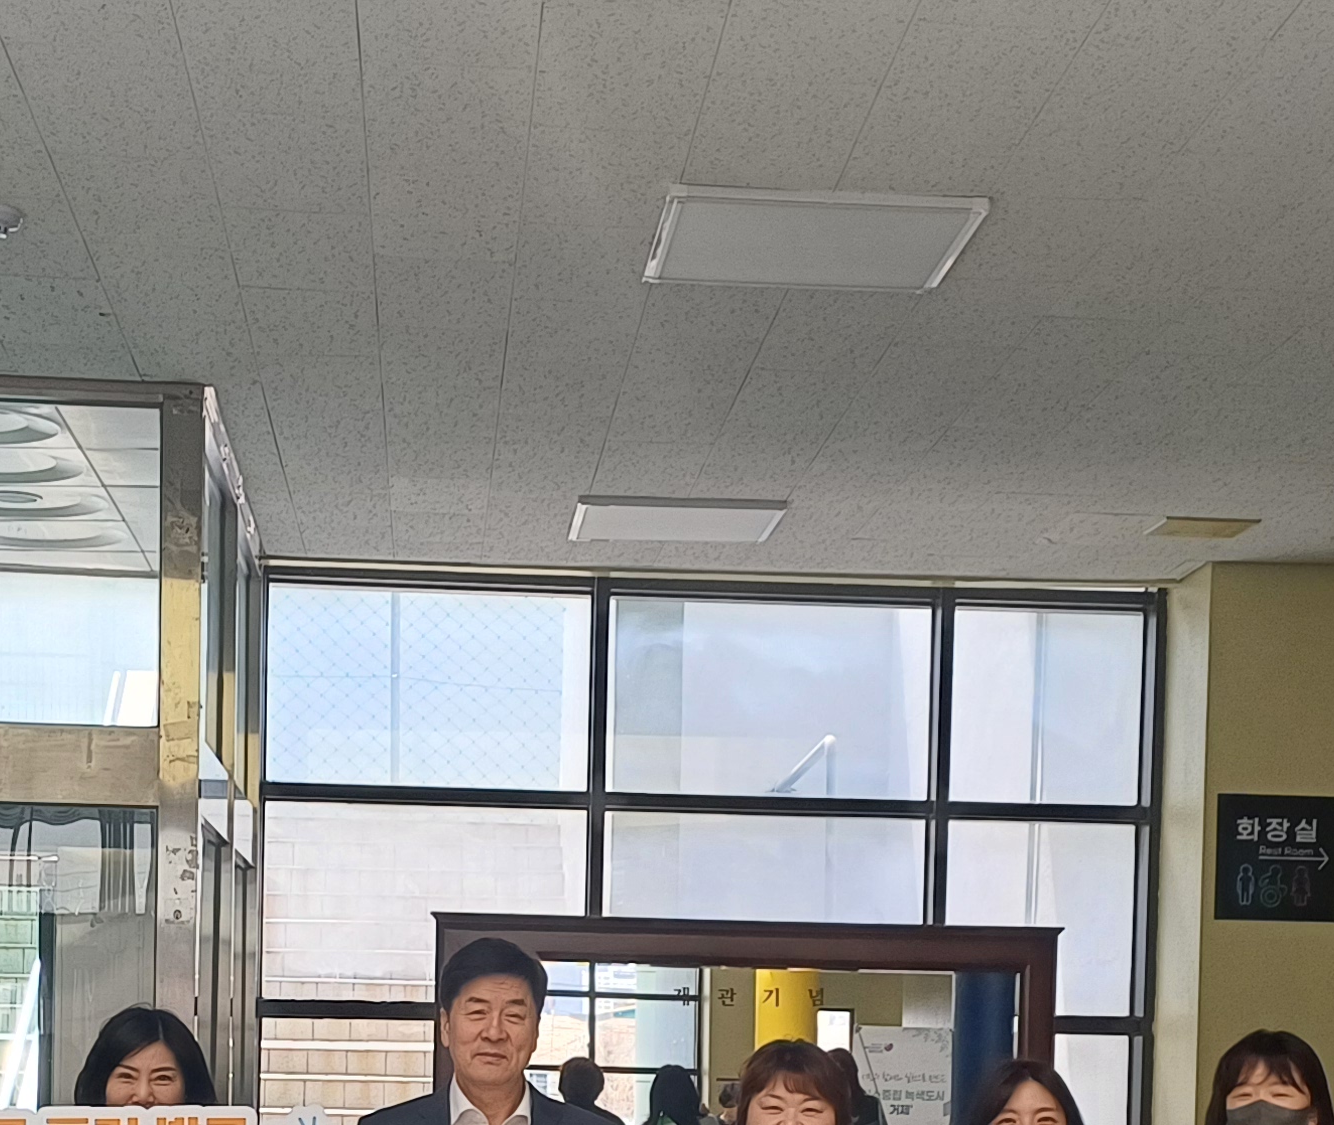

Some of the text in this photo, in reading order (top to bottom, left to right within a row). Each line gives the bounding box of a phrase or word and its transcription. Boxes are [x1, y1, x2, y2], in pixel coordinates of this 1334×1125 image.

[1236, 816, 1318, 843] 화장실
[1259, 845, 1314, 856] Rest Room
